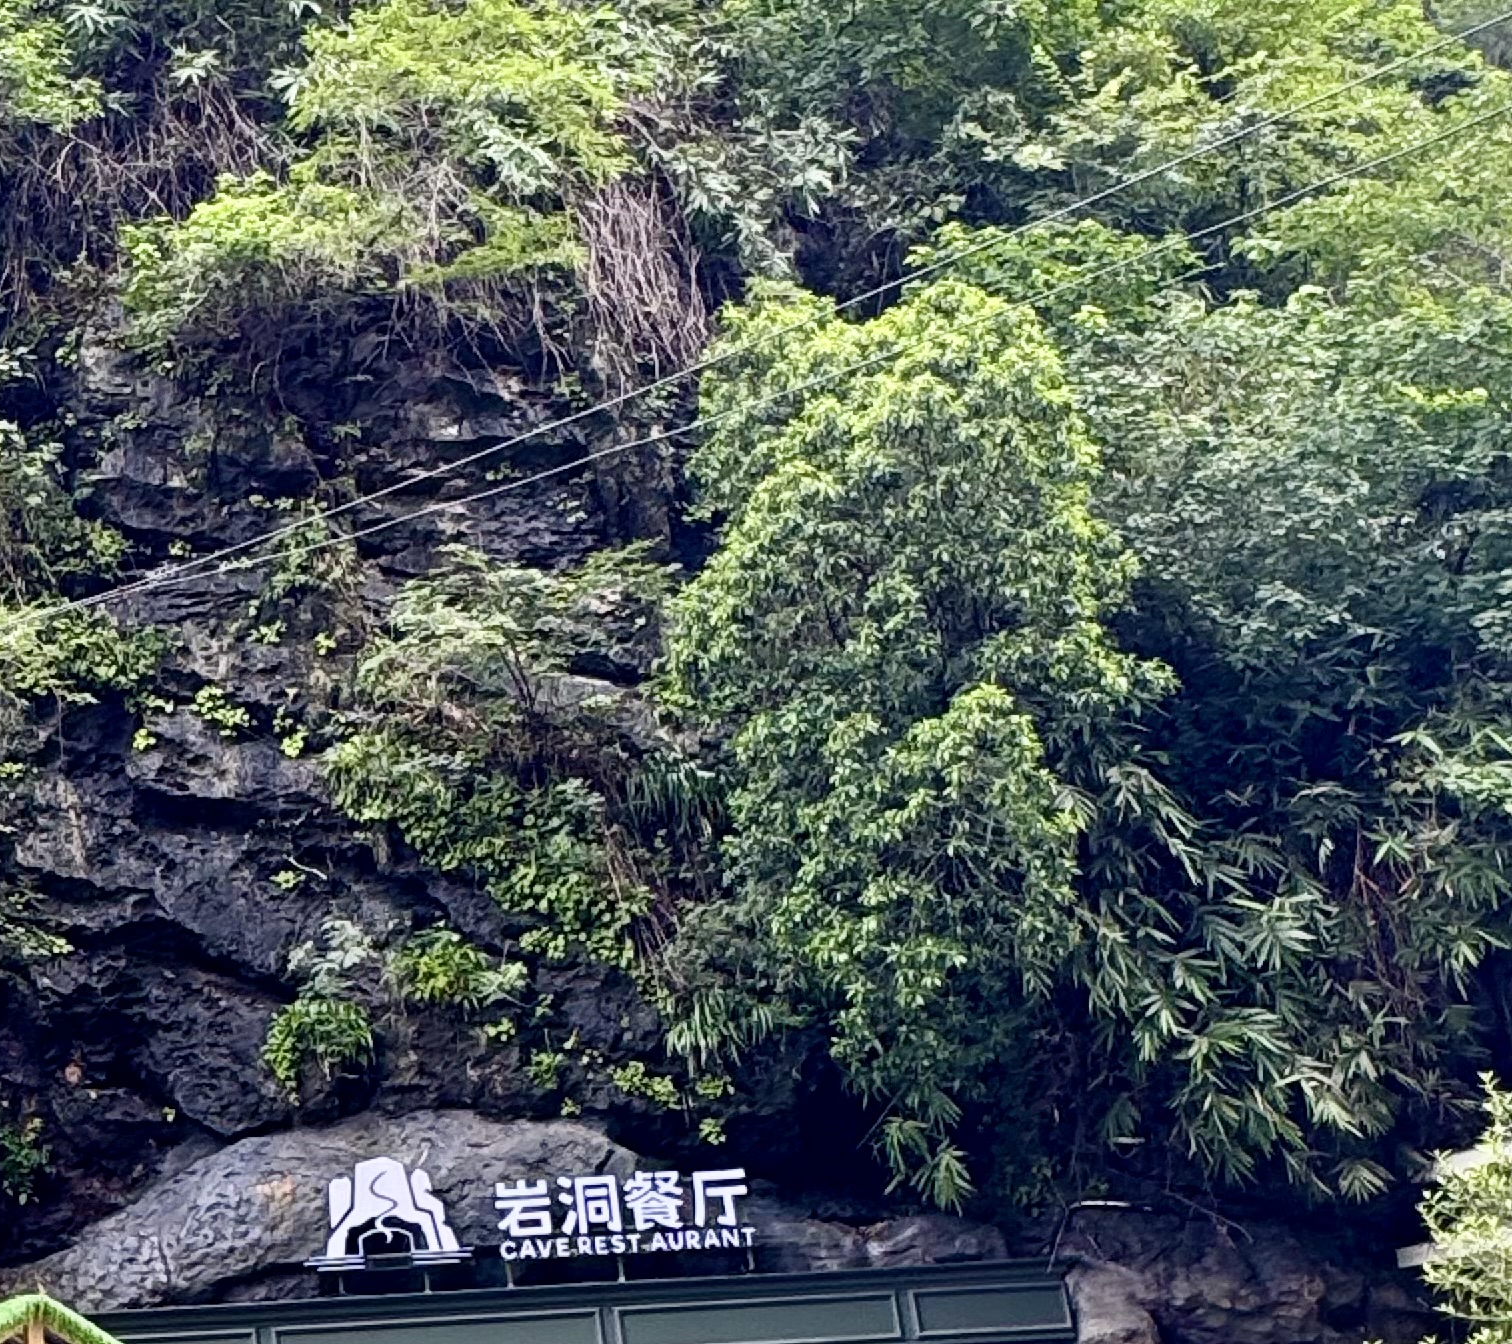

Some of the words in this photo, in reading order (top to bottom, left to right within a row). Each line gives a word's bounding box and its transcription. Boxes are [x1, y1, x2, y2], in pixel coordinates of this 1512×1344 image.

[494, 1168, 748, 1237] 岩洞餐厅
[500, 1237, 571, 1260] CAVE
